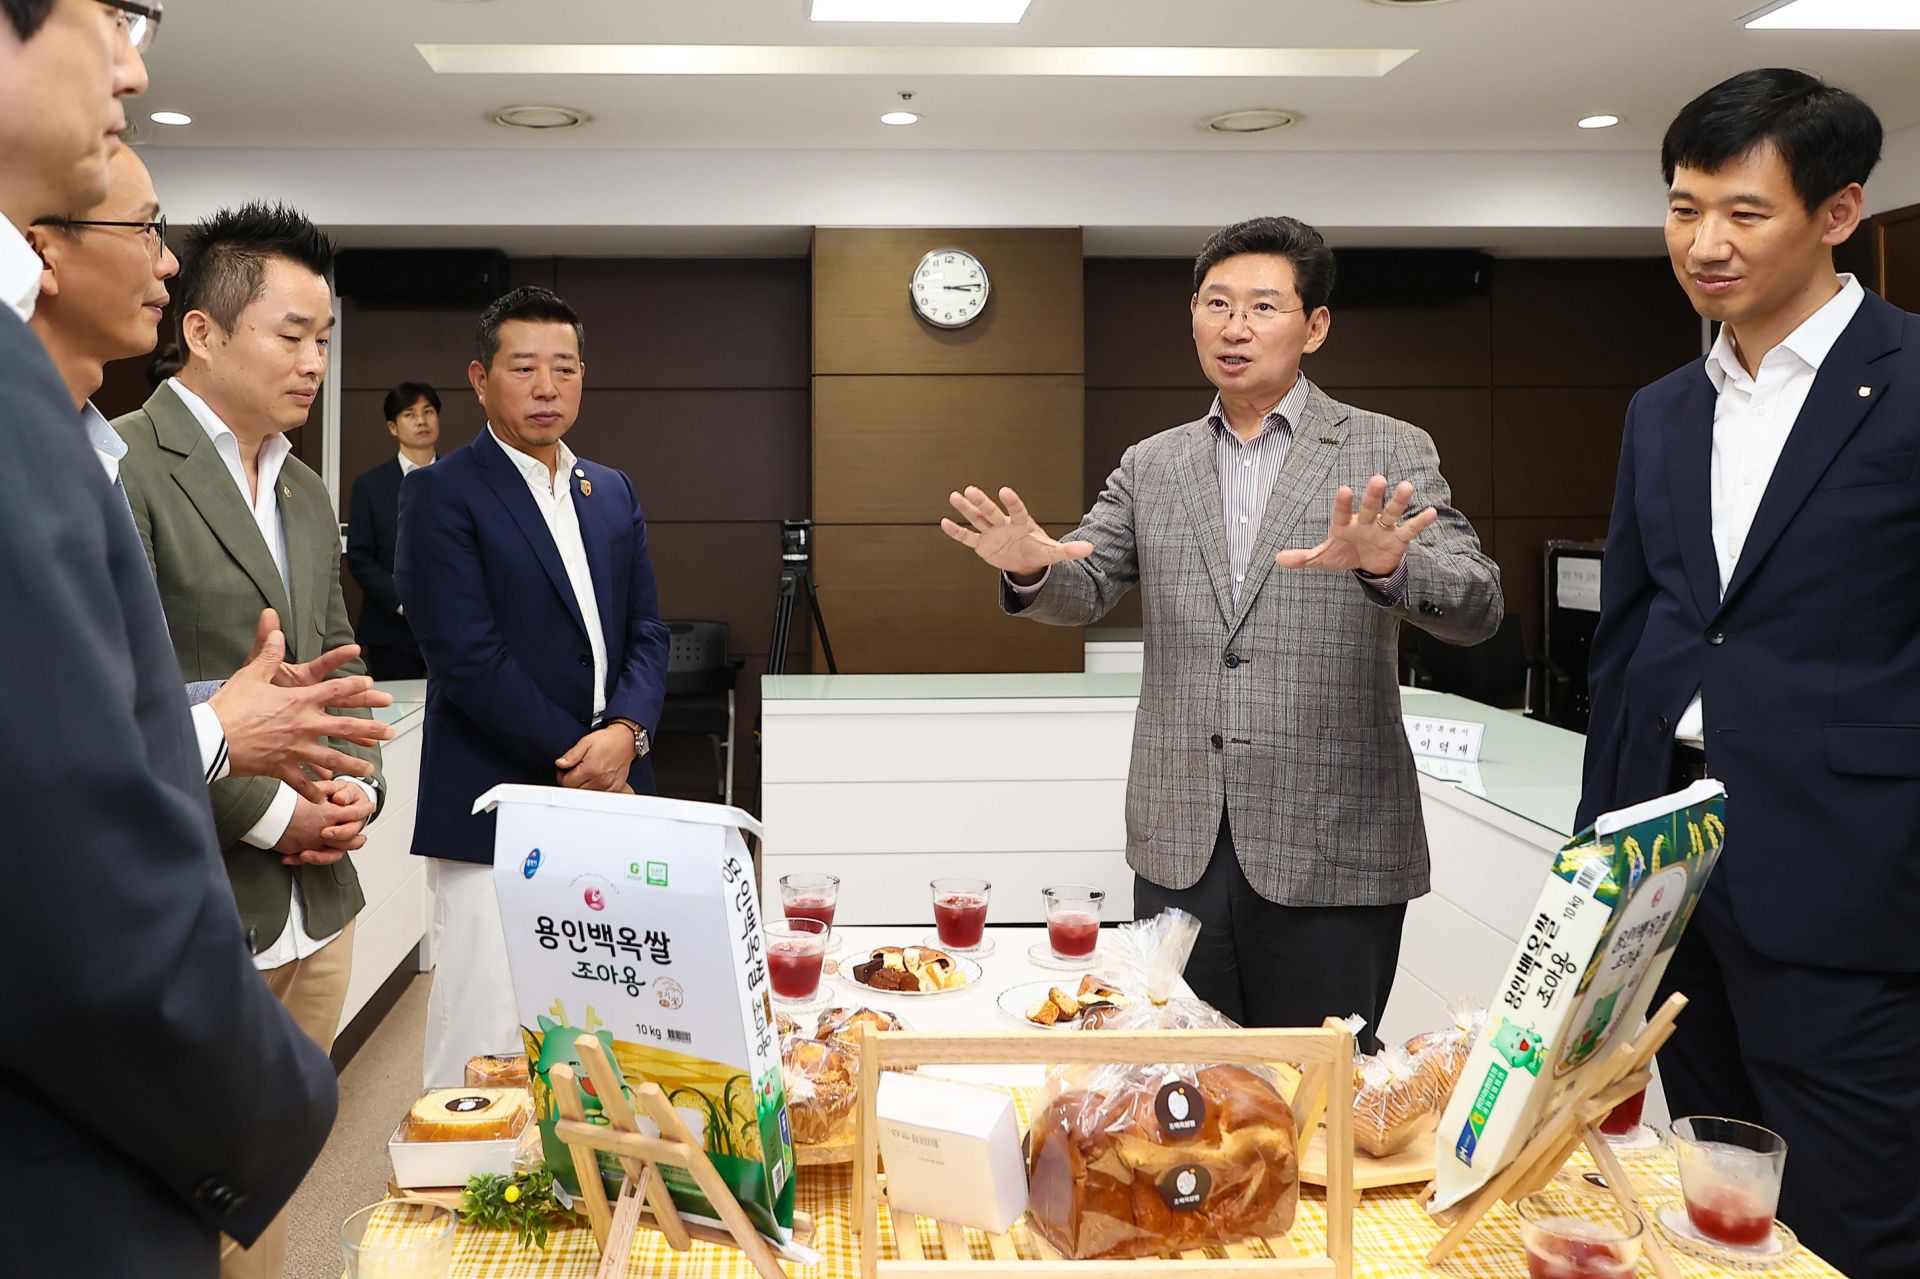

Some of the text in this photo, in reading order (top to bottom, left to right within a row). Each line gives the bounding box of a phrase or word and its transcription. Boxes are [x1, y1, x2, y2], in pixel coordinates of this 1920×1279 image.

[944, 255, 955, 264] 12
[969, 270, 977, 278] 2
[917, 283, 924, 291] 9
[974, 284, 982, 292] 3
[921, 297, 928, 305] 8
[969, 298, 976, 306] 4
[931, 308, 937, 316] 7
[945, 311, 952, 320] 6
[959, 308, 967, 316] 5
[1563, 894, 1585, 921] 10 kg
[722, 856, 766, 992] 용인백옥쌀
[534, 914, 673, 966] 용인백옥쌀
[1503, 912, 1561, 1010] 용인백옥쌀
[571, 961, 646, 998] 조아용
[1535, 951, 1578, 1009] 조아용
[635, 1023, 662, 1040] 10 kg
[752, 998, 772, 1058] 조아용
